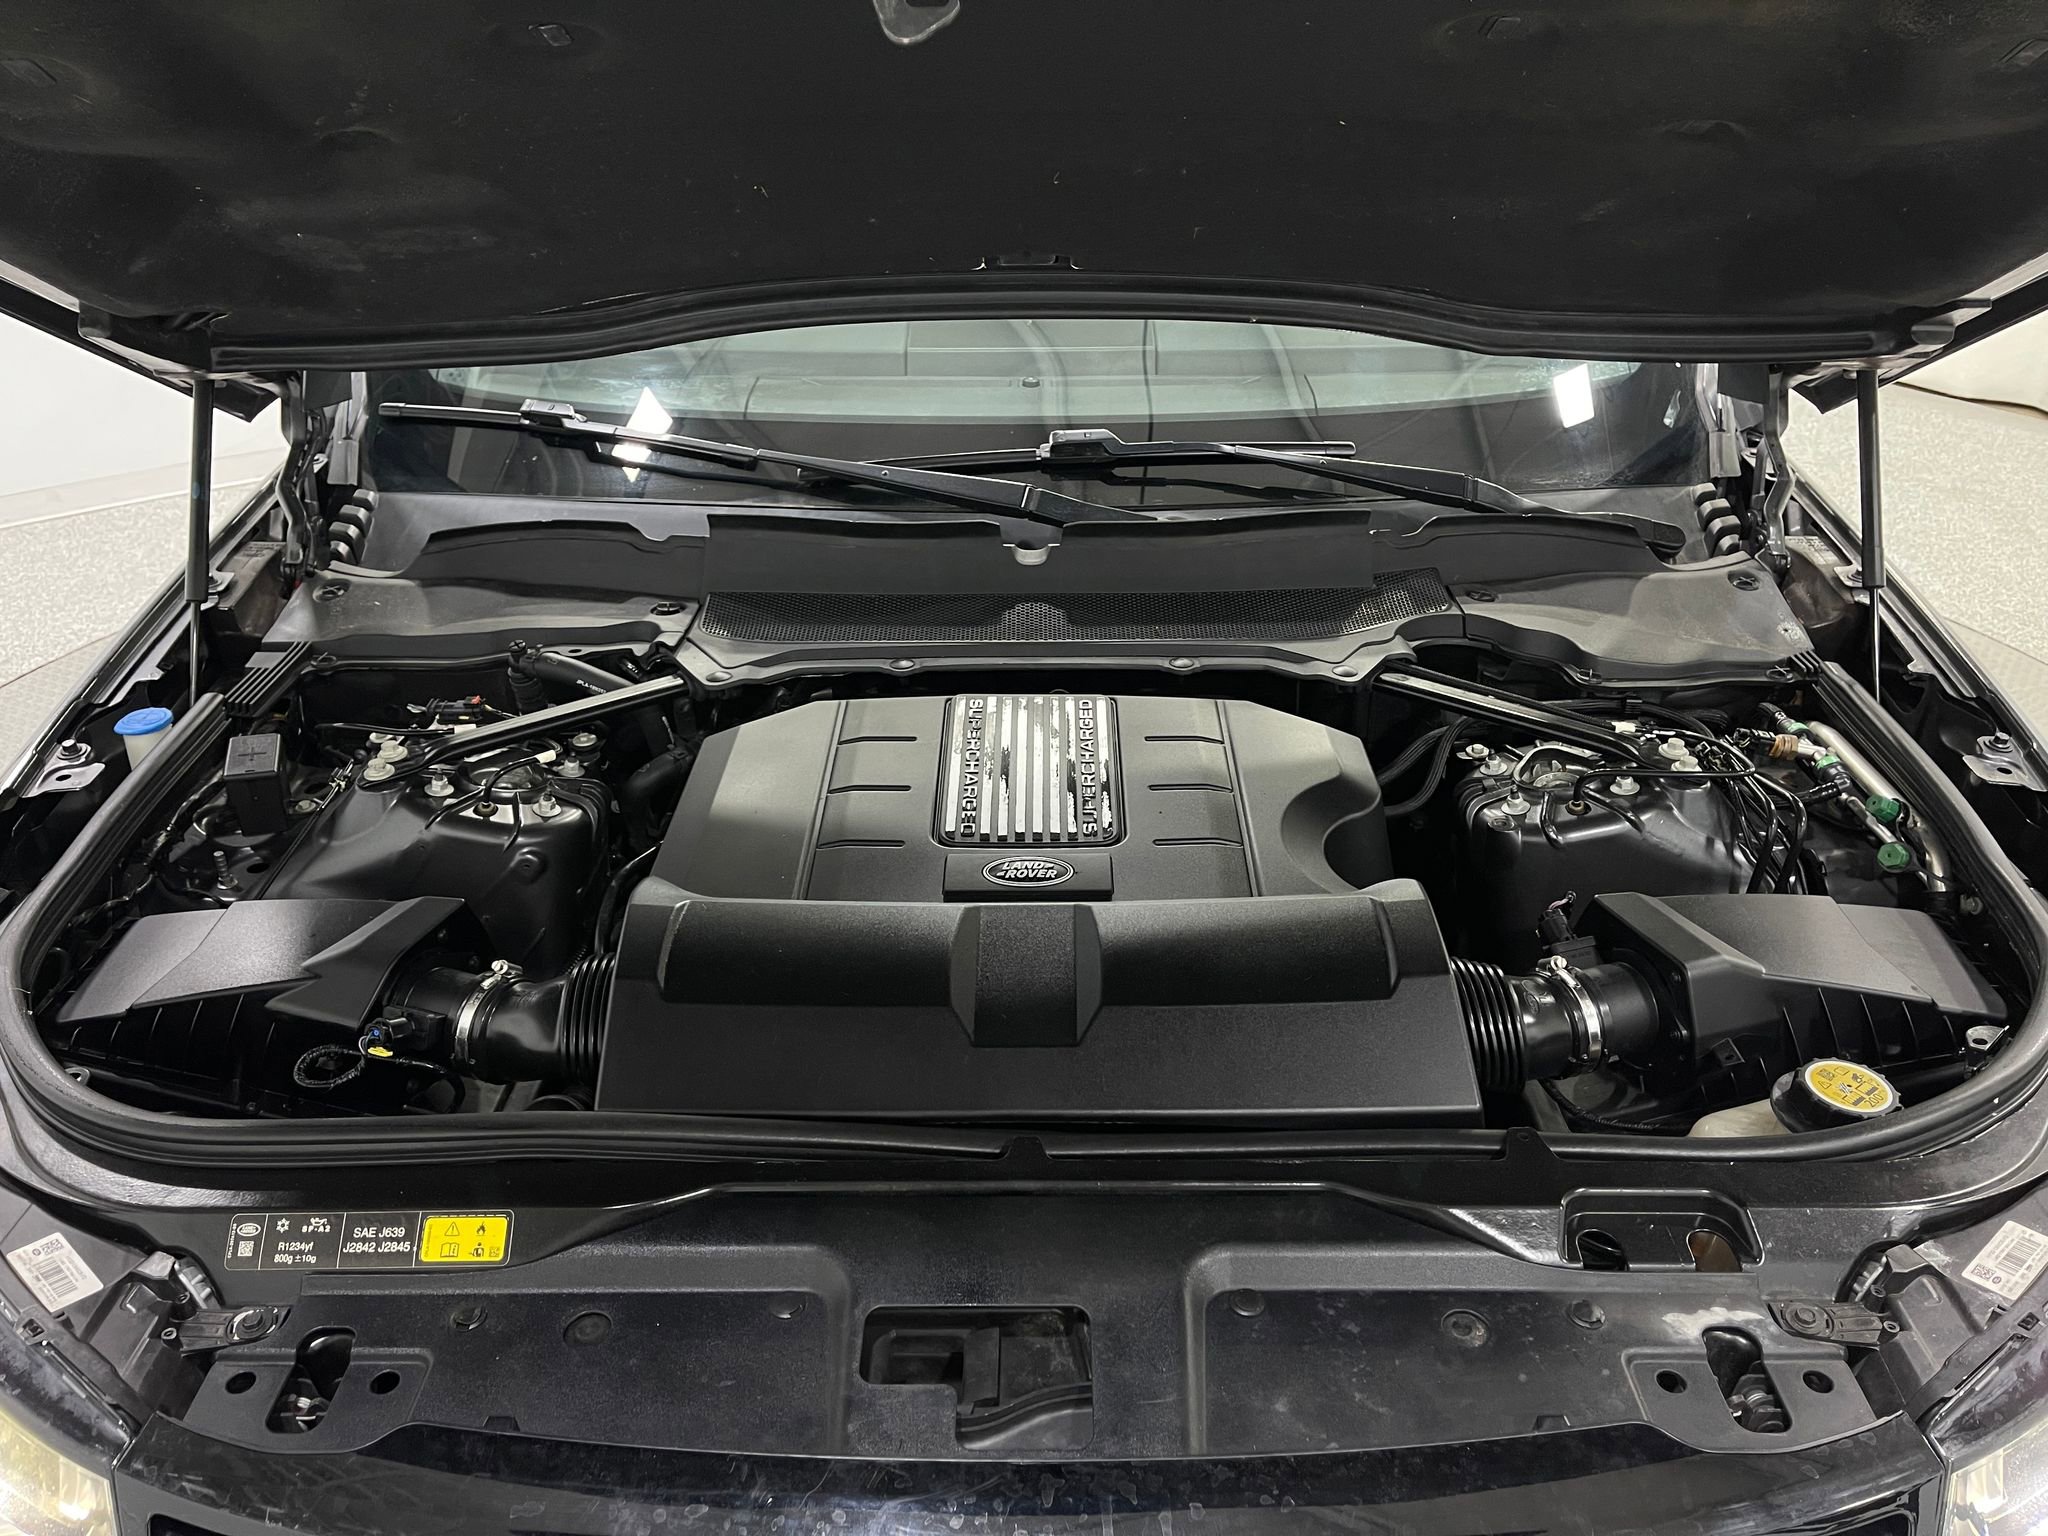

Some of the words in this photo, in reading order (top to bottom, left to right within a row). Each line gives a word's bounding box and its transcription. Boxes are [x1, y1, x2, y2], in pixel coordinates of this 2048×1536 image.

[961, 698, 983, 837] SUPERCHARGED
[1079, 699, 1098, 837] SUPERCHARGED
[1002, 861, 1044, 870] LAND
[1004, 869, 1058, 878] ROVER
[353, 1226, 377, 1239] SAE
[378, 1226, 406, 1238] J639
[277, 1241, 314, 1253] R1234yf
[342, 1241, 377, 1253] J2842
[377, 1241, 411, 1253] J2845
[273, 1253, 293, 1265] 800g
[294, 1254, 317, 1264] ±10g
